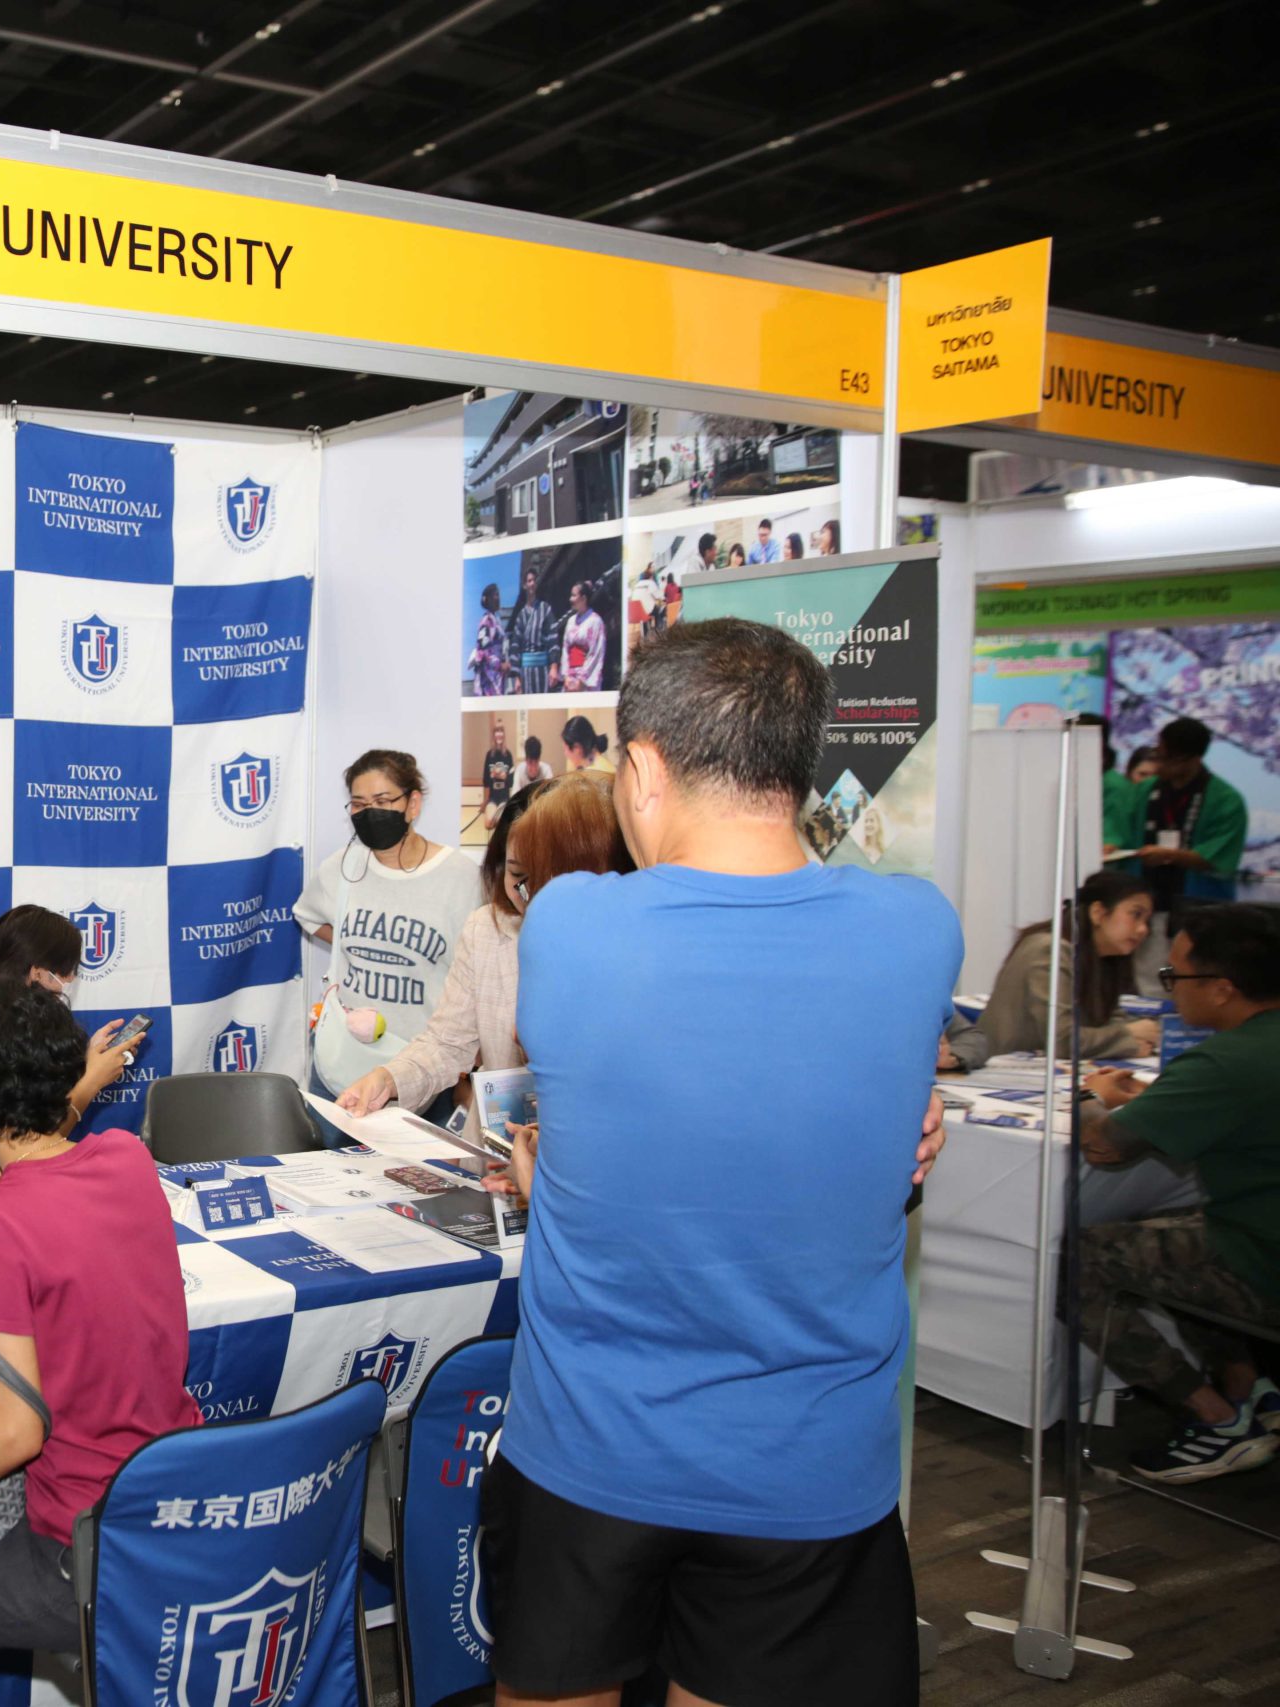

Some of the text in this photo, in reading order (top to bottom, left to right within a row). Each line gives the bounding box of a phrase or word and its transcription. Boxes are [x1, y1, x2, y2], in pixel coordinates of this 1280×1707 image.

[3, 205, 294, 289] UNIVERSITY
[927, 296, 1012, 328] มหาวิทยาลัย
[941, 331, 993, 354] TOKYO
[932, 355, 999, 379] SAITAMA
[841, 369, 870, 393] E43
[1042, 366, 1185, 419] UNIVERSITY
[68, 473, 126, 494] TOKYO
[27, 487, 161, 519] INTERNATIONAL
[44, 511, 142, 537] UNIVERSITY
[222, 622, 268, 640] TOKYO
[774, 608, 833, 631] Tokyo
[794, 619, 910, 647] ternational
[183, 637, 304, 663] INTERNATIONAL
[820, 647, 876, 668] ersity
[199, 657, 290, 681] UNIVERSITY
[835, 706, 920, 721] Scholarships
[837, 696, 918, 707] Tuition Reduction
[826, 731, 917, 745] 50% 80% 100%
[68, 764, 121, 780] TOKYO
[27, 783, 157, 802] INTERNATIONAL
[42, 804, 140, 822] UNIVERSITY
[223, 894, 263, 917] TOKYO
[180, 908, 293, 942] INTERNATIONAL
[198, 926, 273, 961] UNIVERSITY
[350, 949, 410, 966] DESIGN
[343, 962, 424, 1006] STUDIO
[93, 1088, 141, 1103] RSITY
[335, 1336, 430, 1399] TOKYO UNIVERSITY
[452, 1525, 472, 1597] TOKYO
[155, 1604, 181, 1681] TOKYO
